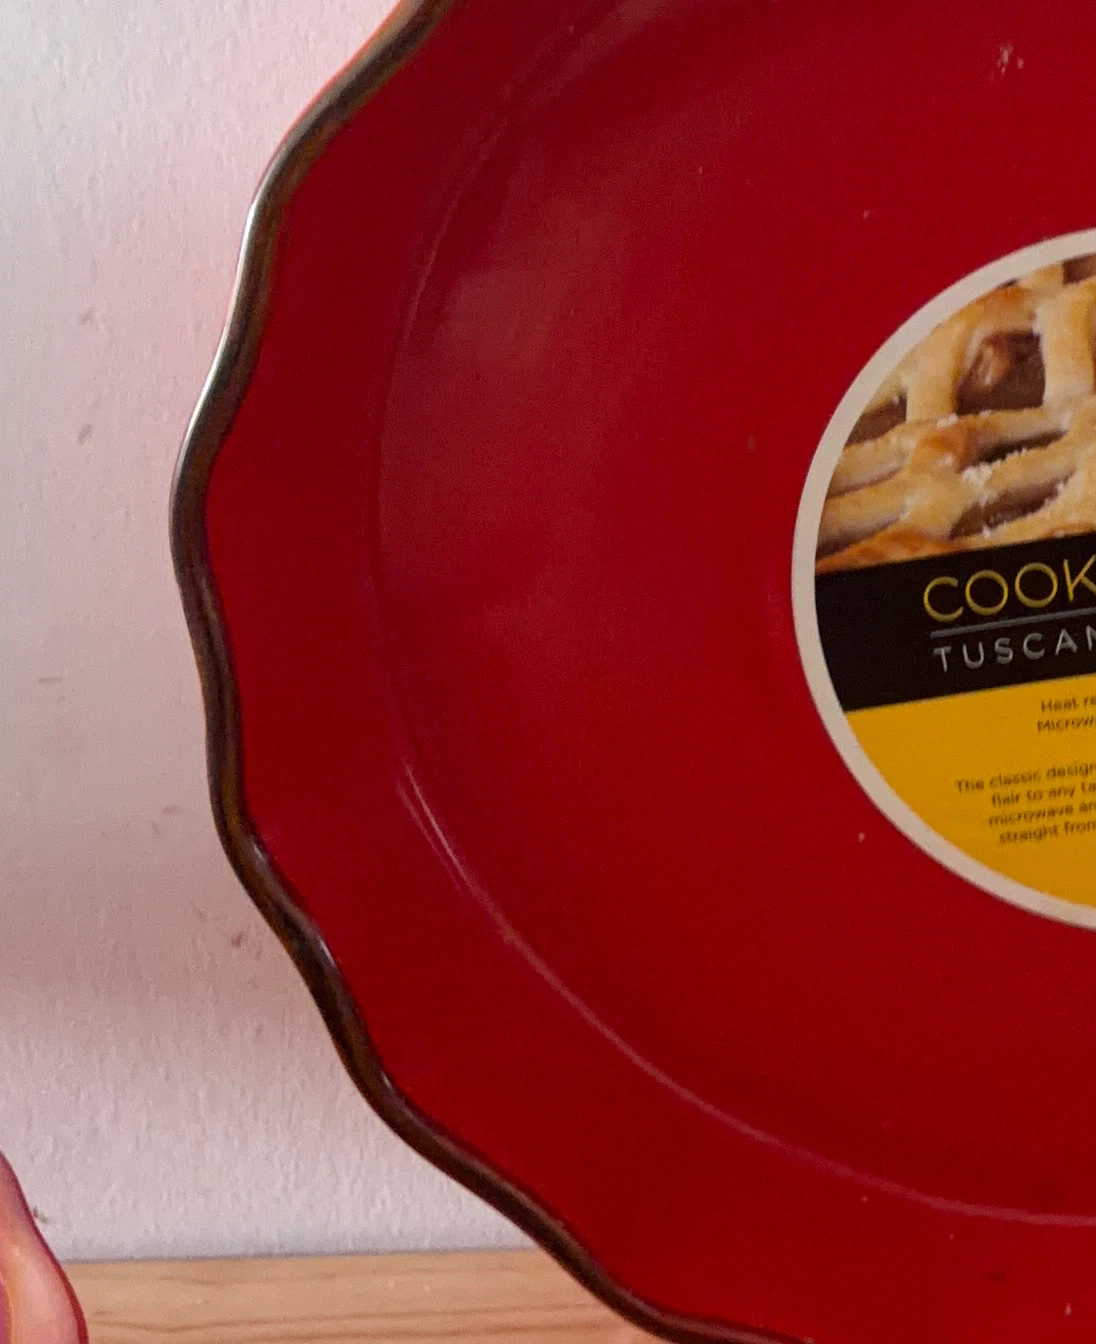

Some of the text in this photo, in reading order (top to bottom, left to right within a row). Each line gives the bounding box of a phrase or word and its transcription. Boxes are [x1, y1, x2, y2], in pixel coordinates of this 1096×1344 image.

[1041, 698, 1079, 713] Heat
[955, 778, 984, 794] The
[990, 770, 1041, 789] classic
[991, 792, 1021, 808] flair
[1027, 788, 1043, 802] to
[1048, 784, 1075, 799] any
[989, 804, 1074, 827] microwave
[999, 823, 1059, 845] straight
